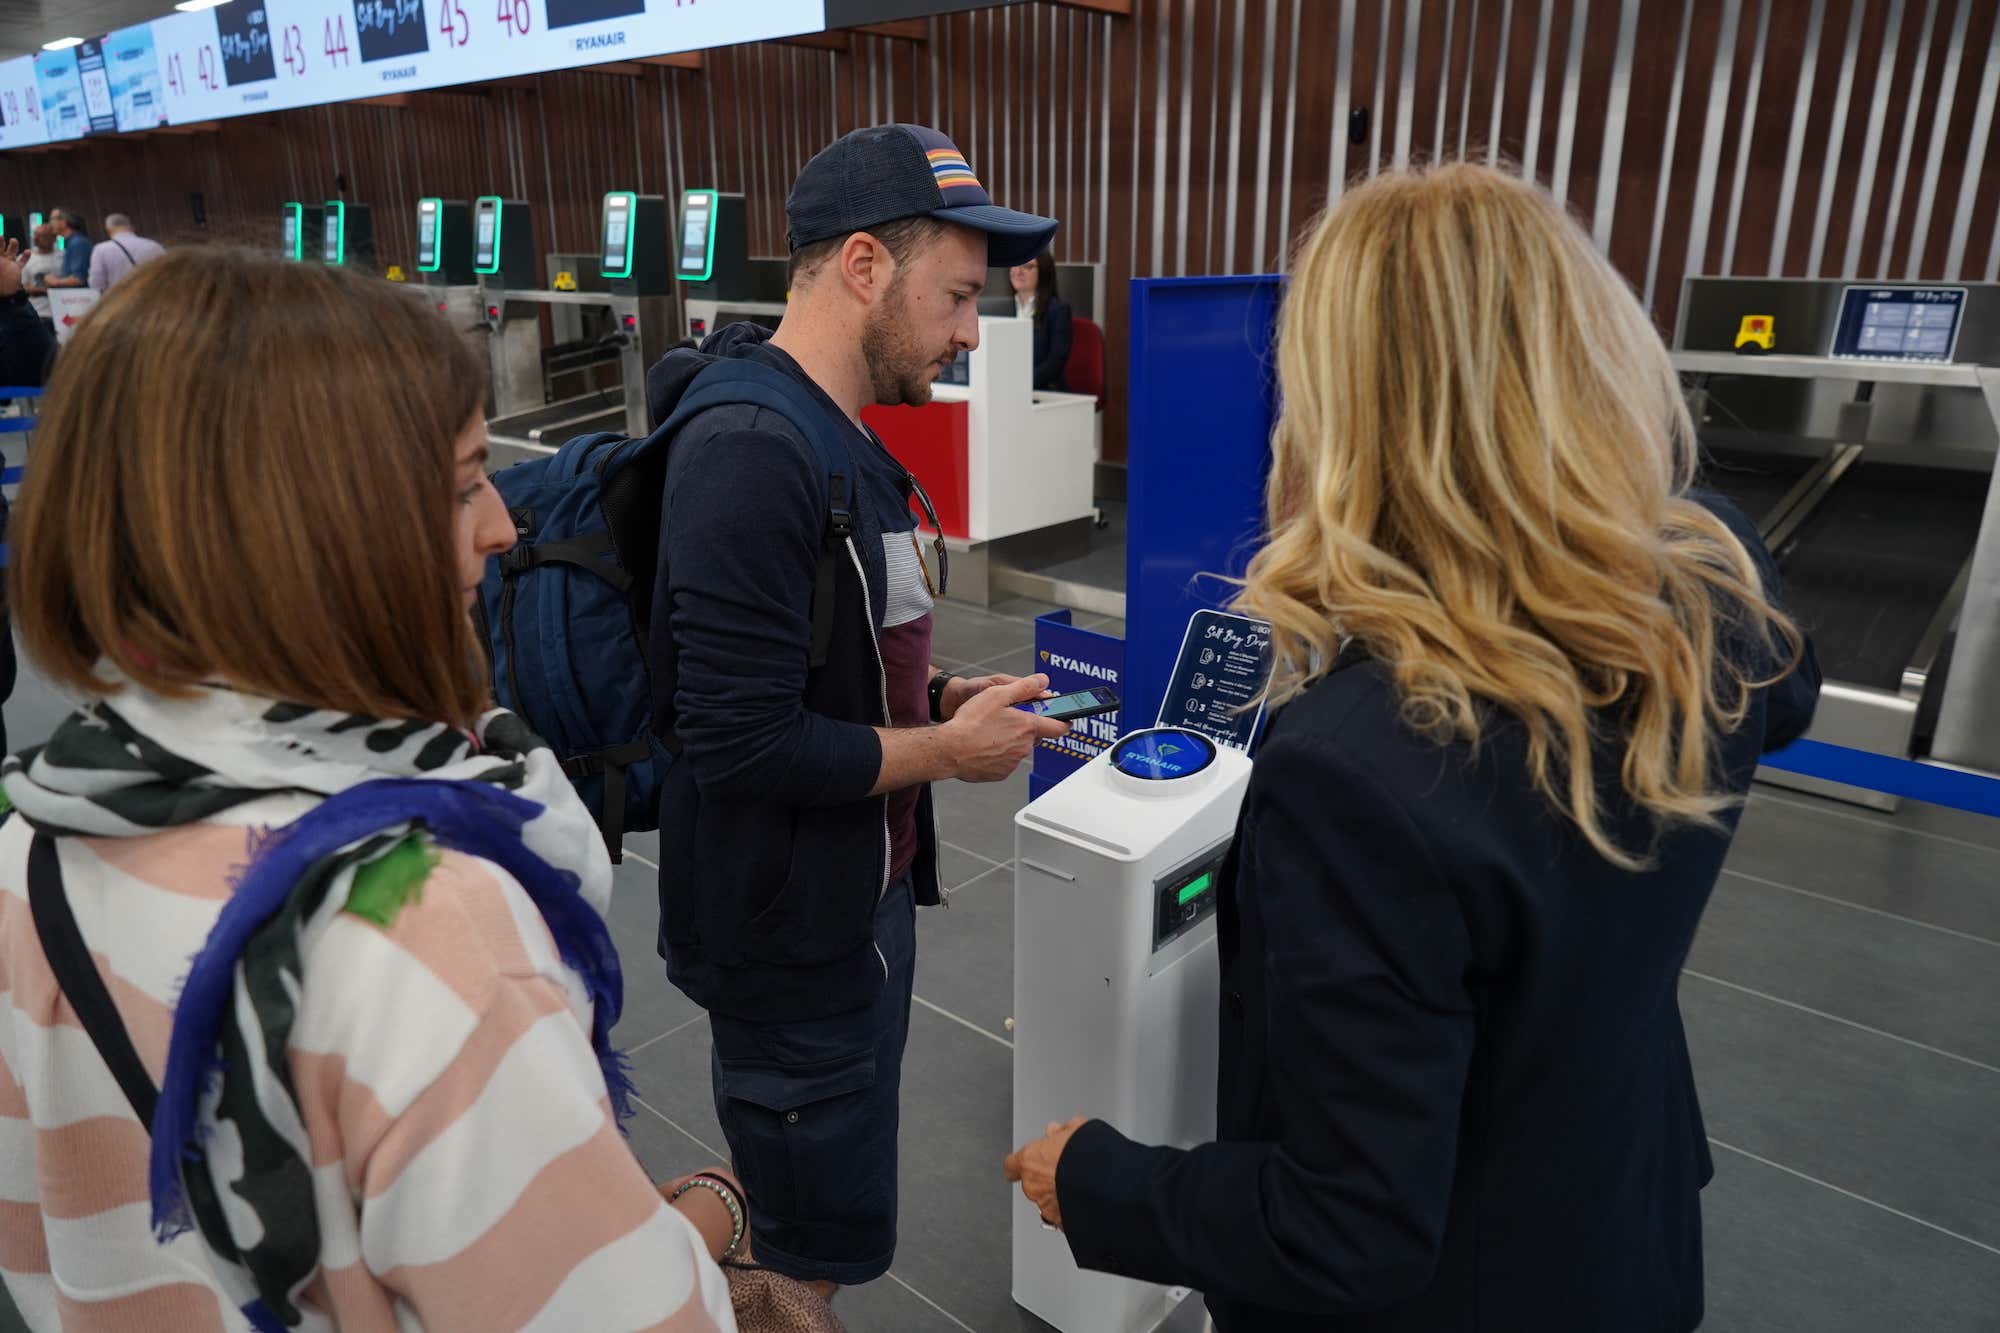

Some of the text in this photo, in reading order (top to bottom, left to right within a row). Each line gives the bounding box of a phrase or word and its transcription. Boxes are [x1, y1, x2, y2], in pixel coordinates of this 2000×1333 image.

[440, 0, 469, 48] 45
[283, 14, 349, 76] 43 44
[575, 32, 626, 51] RYANAIR
[168, 45, 219, 96] 41 42
[381, 66, 417, 81] RYANAIR
[1204, 625, 1269, 651] Self Bag Drop
[1050, 653, 1119, 683] RYANAIR
[1216, 654, 1222, 663] 1
[1207, 678, 1215, 688] 2
[1198, 703, 1207, 712] 3
[1090, 718, 1119, 743] THE
[1065, 737, 1099, 757] YELLOW
[1125, 751, 1183, 772] RYANAIR
